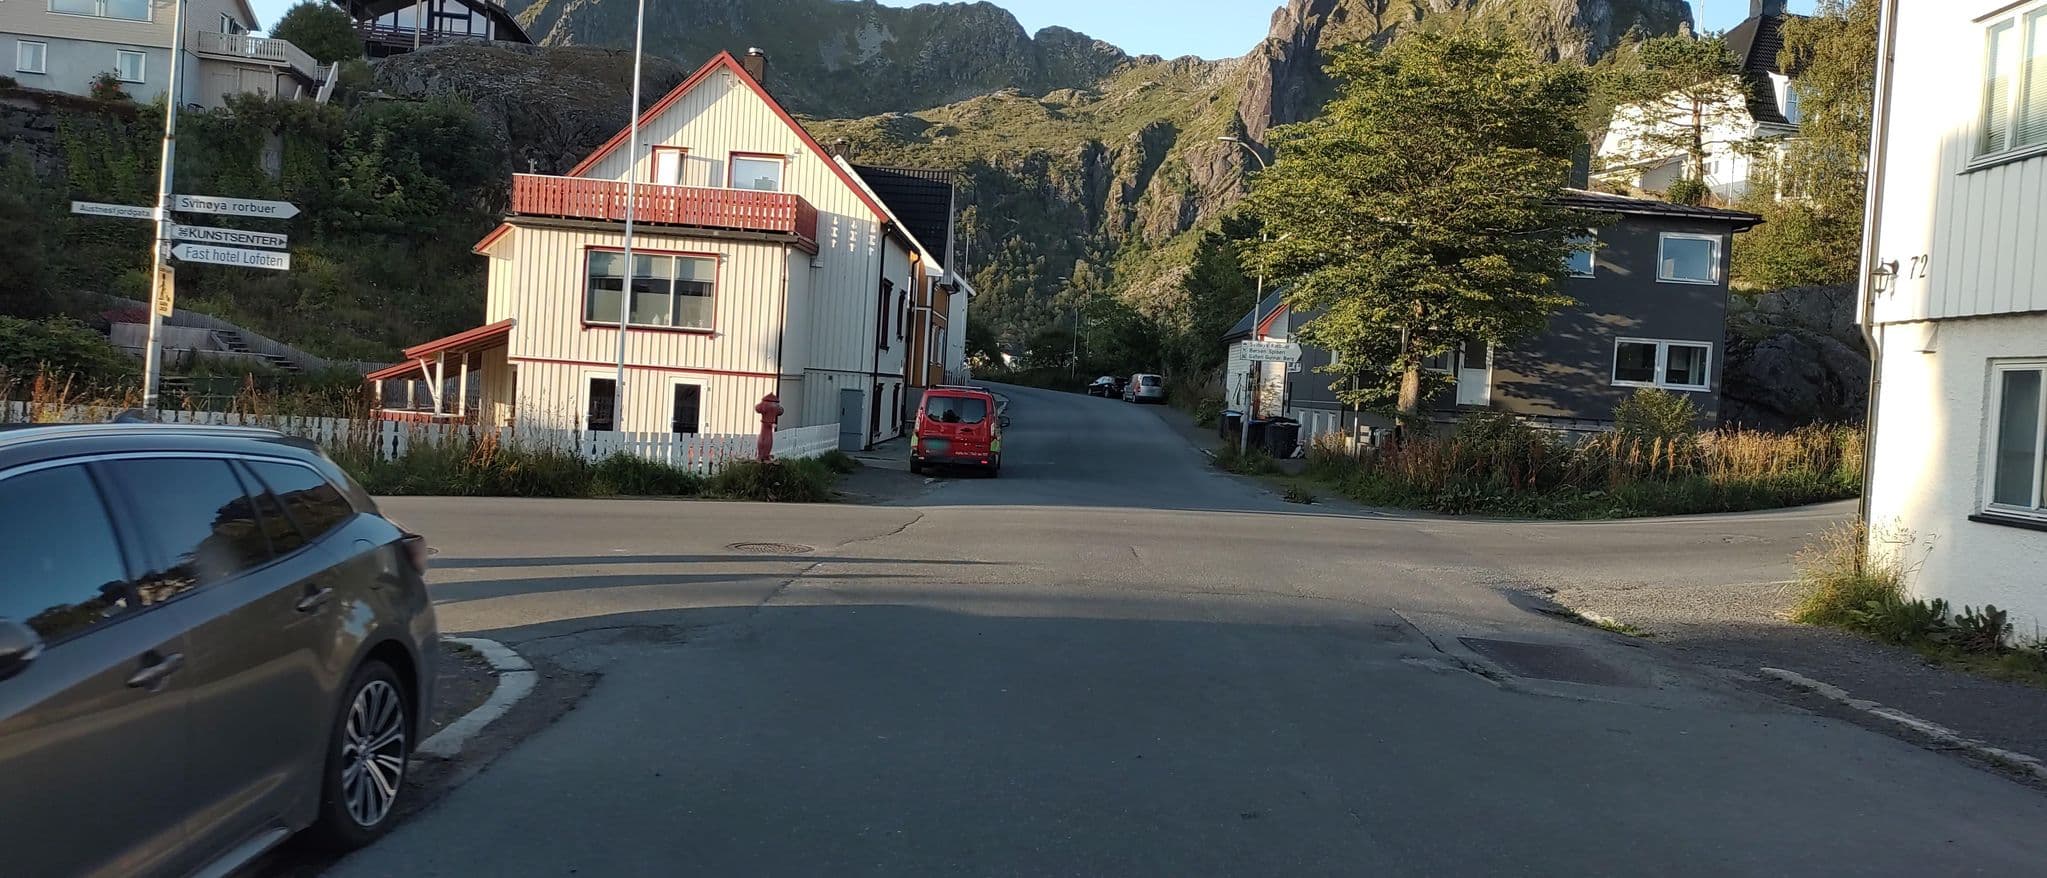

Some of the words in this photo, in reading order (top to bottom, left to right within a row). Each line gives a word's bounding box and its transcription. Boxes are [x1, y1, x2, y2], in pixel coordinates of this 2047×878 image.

[181, 197, 227, 212] Svinøya
[232, 203, 276, 213] rorbuer
[189, 228, 278, 246] KUNSTSENTER
[185, 246, 209, 260] Fast
[213, 249, 240, 263] hotel
[243, 251, 283, 266] Lofoten
[1910, 253, 1929, 280] 72
